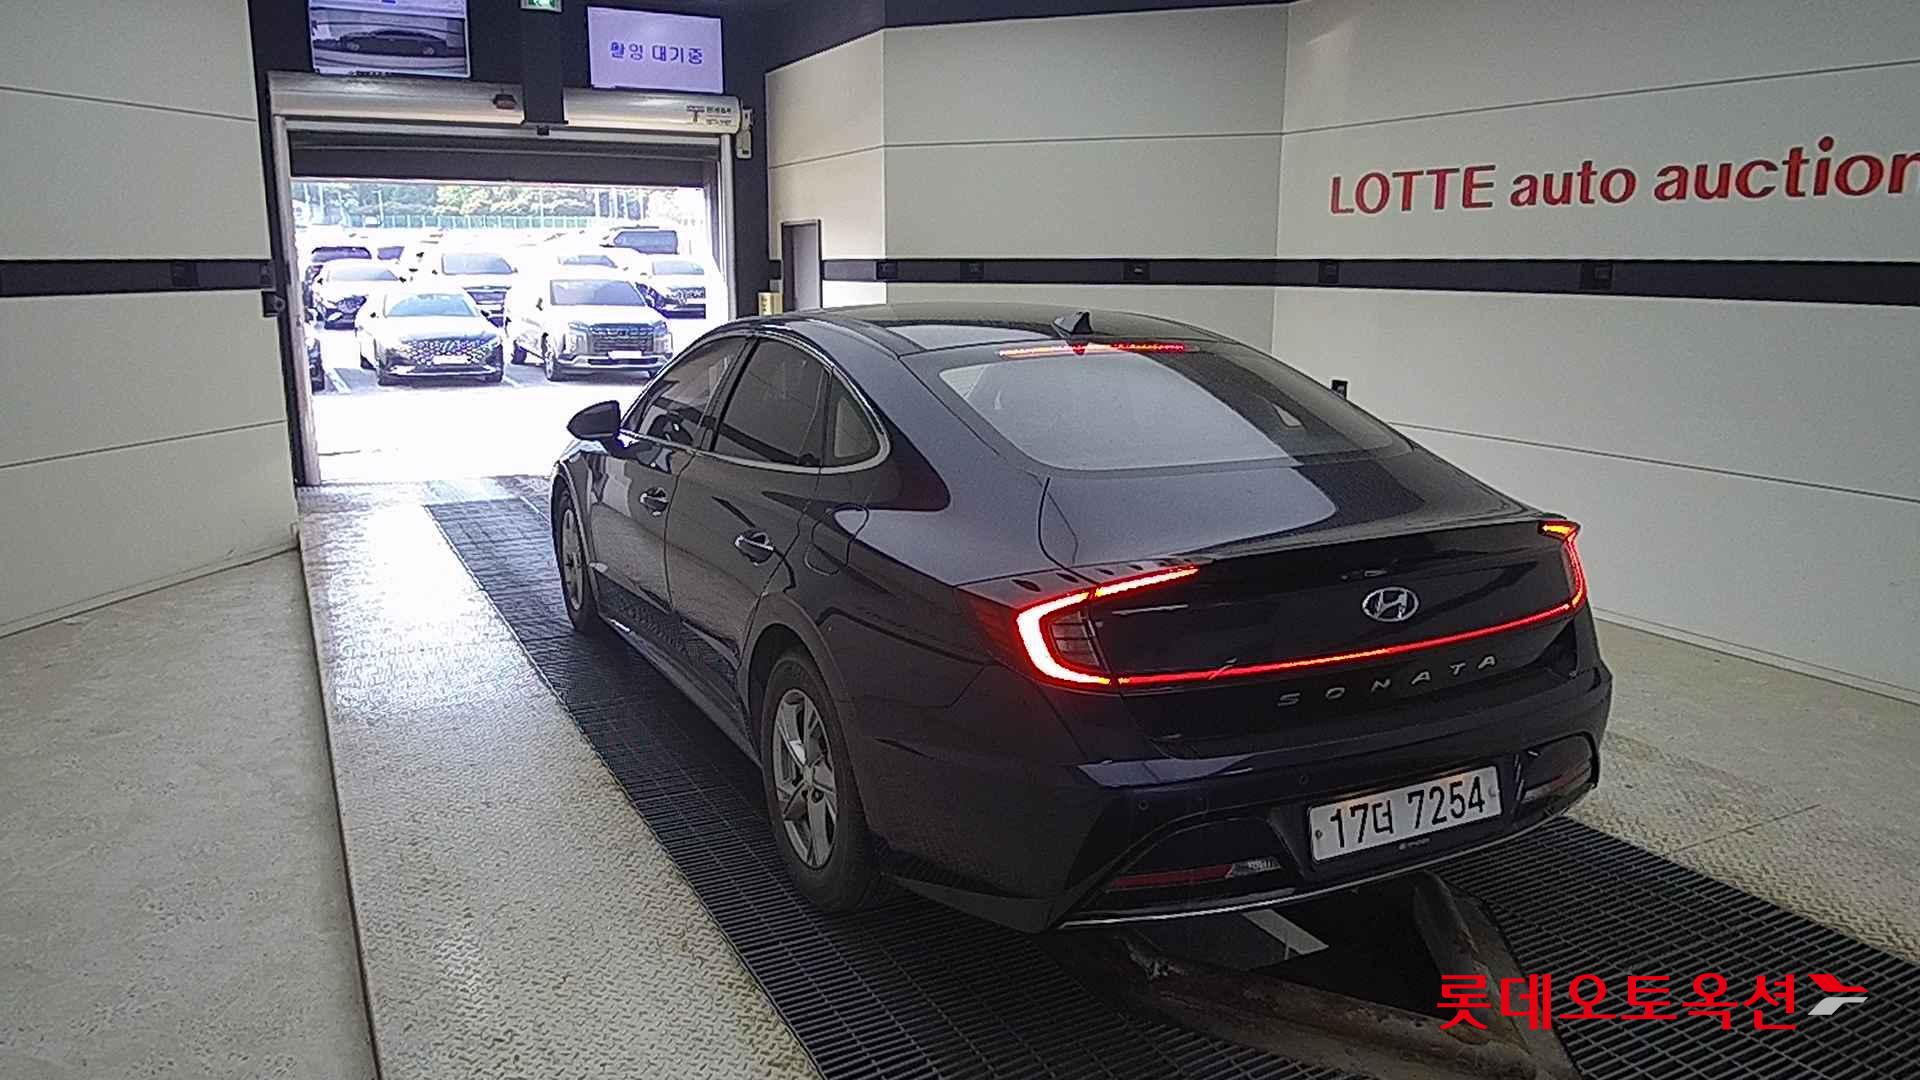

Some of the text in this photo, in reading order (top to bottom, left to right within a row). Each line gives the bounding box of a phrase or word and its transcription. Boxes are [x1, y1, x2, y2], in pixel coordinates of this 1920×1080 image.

[651, 44, 704, 65] 대기중
[1330, 164, 1497, 215] LOTTE
[1510, 159, 1638, 207] auto
[1276, 655, 1497, 706] SONATA
[1329, 776, 1485, 849] 17더 7254
